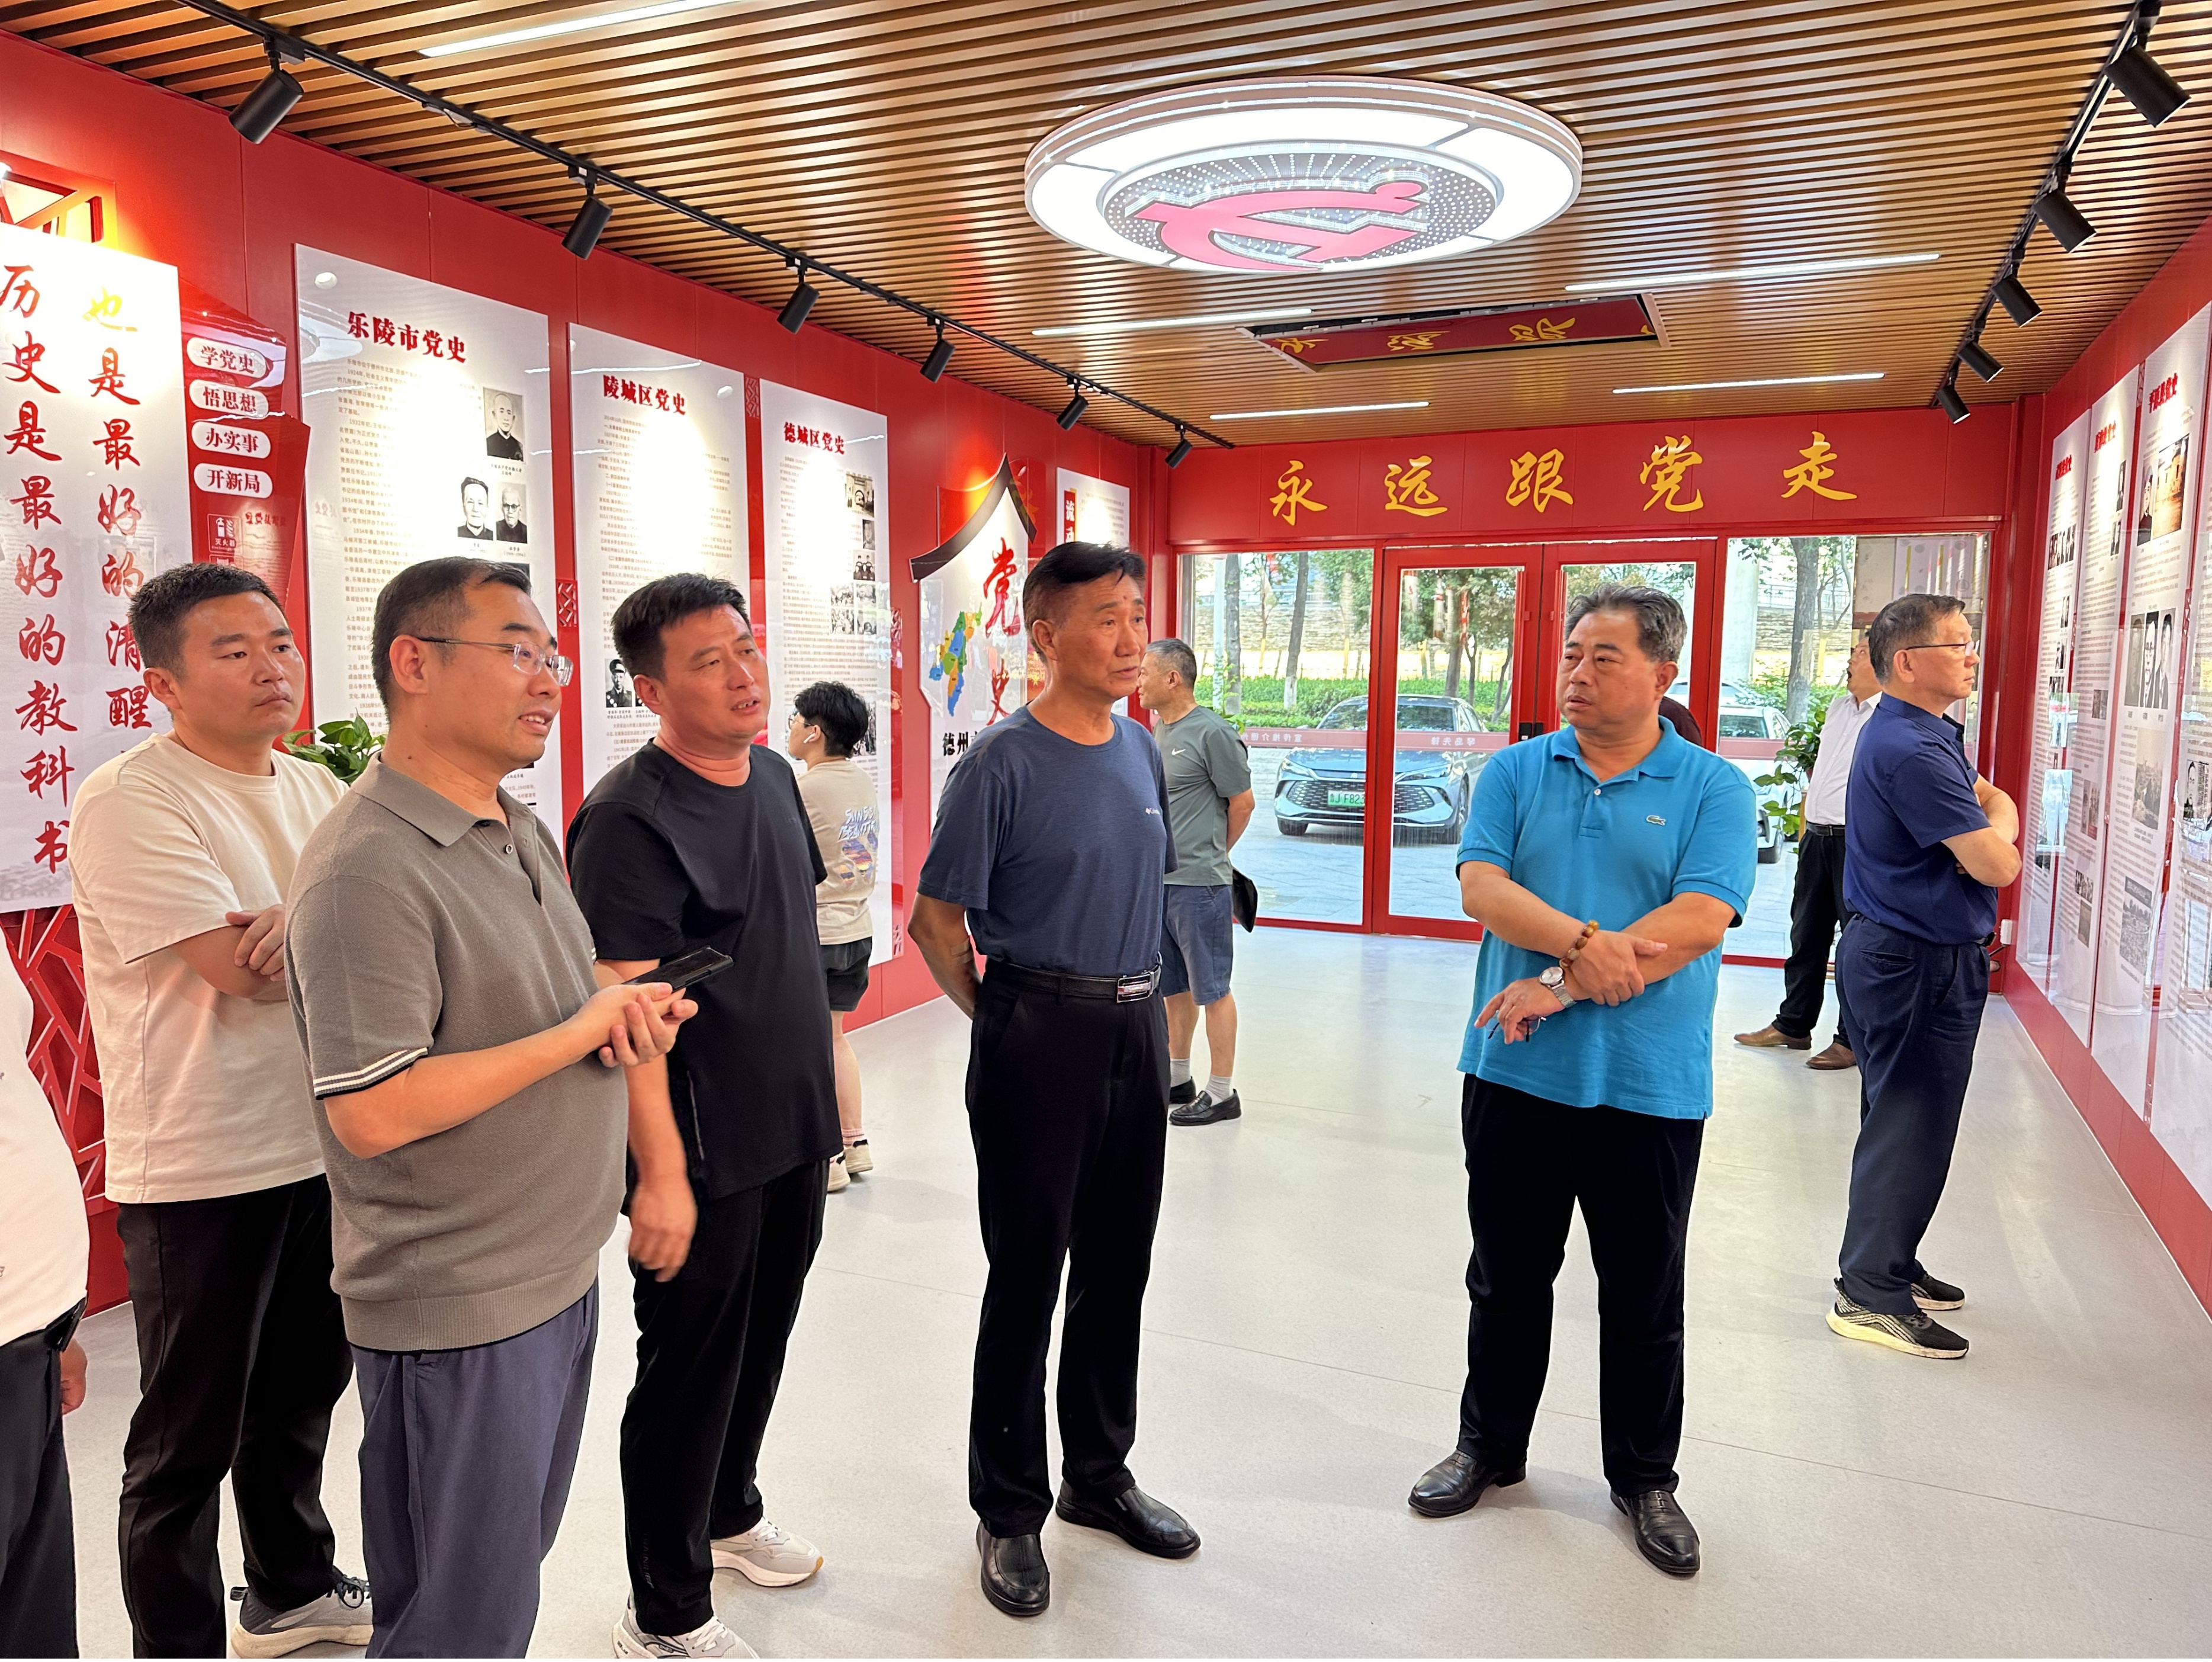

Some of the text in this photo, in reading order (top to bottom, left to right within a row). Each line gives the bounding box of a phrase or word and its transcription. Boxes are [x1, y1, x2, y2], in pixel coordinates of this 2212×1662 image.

[348, 311, 466, 363] 乐陵市党史
[200, 345, 255, 374] 学党史
[203, 386, 256, 412] 悟思想
[602, 375, 686, 415] 陵城区党史
[206, 428, 259, 453] 办实事
[784, 422, 845, 455] 德城区党史
[207, 469, 260, 493] 开新局
[1269, 431, 1857, 526] 永远跟党走
[82, 286, 152, 753] 也是最好的清醒
[0, 265, 78, 874] 历史是最好的教科书
